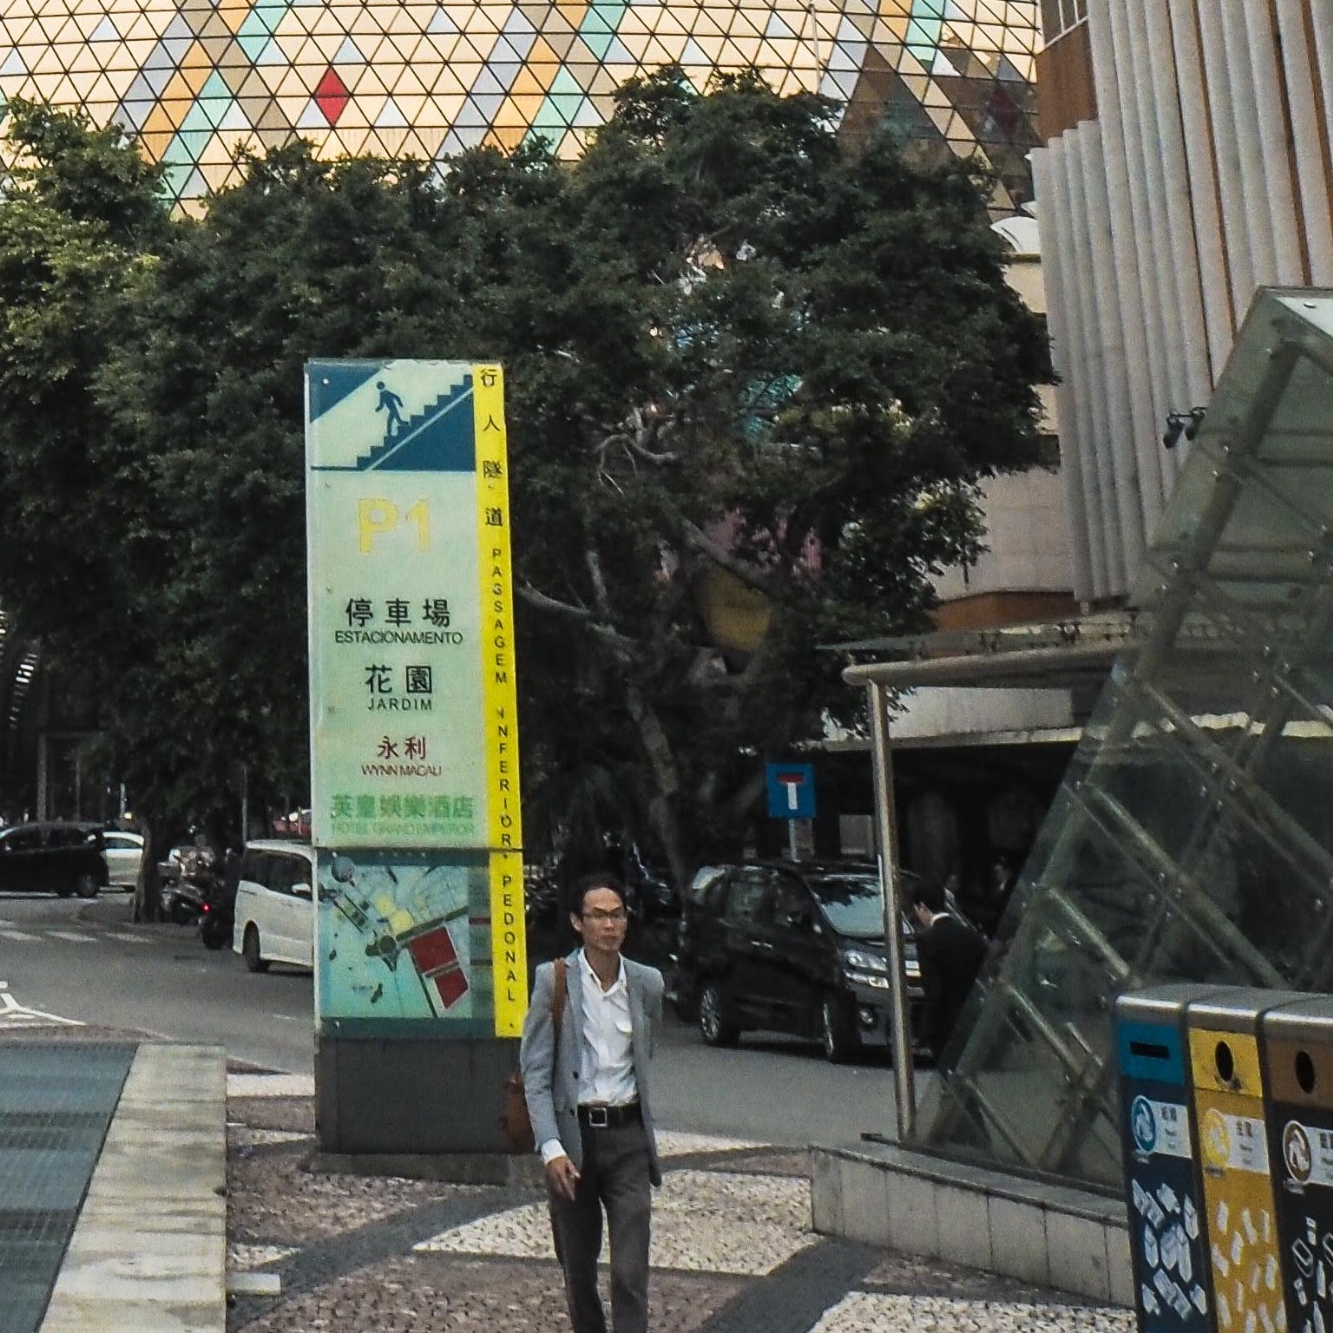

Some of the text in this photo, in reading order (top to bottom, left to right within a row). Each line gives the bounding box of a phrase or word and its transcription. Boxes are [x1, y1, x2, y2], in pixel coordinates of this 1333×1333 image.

[480, 368, 503, 527] 行人隧道
[358, 497, 431, 555] P1
[345, 597, 450, 628] 停車場
[335, 630, 463, 645] ESTACIONAMENTO
[364, 665, 433, 695] 花園
[367, 697, 433, 712] JARDIM
[377, 735, 427, 760] 永利
[361, 764, 442, 776] WYNN MACAU
[492, 548, 516, 1002] PASSAGEM INFERIOR PEDONAL
